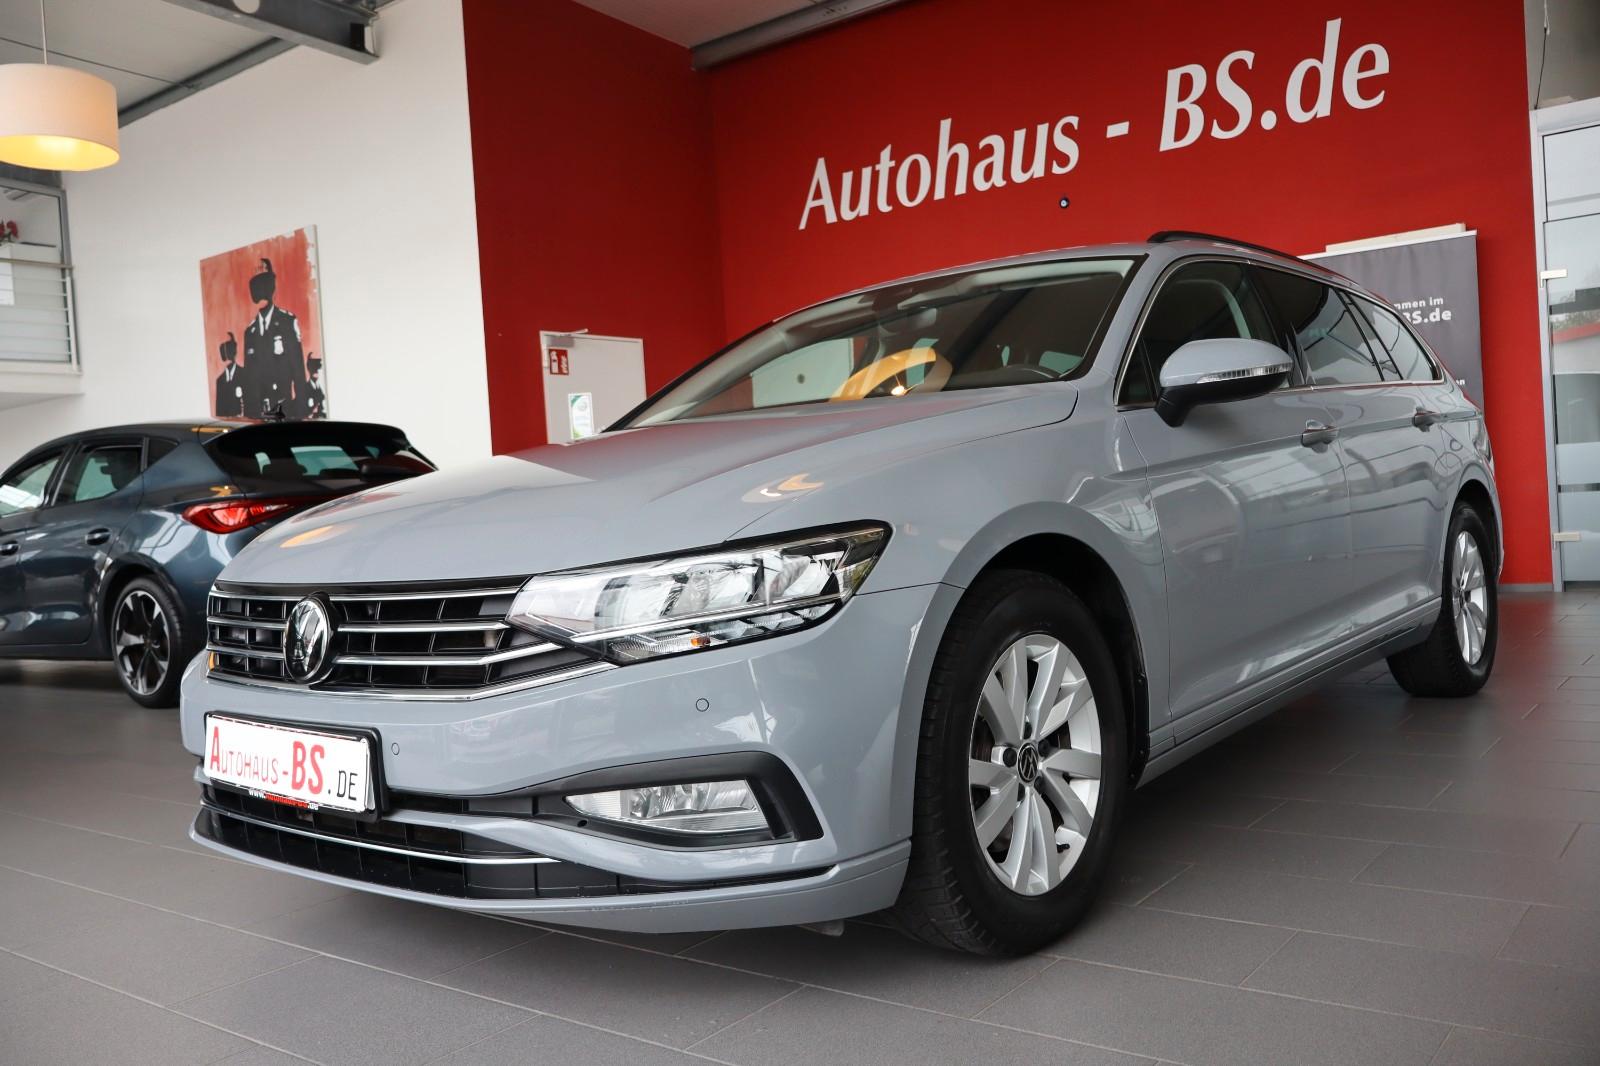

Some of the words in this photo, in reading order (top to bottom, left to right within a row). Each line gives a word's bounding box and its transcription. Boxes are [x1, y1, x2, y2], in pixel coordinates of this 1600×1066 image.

[799, 116, 1079, 230] Autohaus
[1106, 121, 1130, 138] -
[1159, 18, 1390, 152] BS.de
[1429, 296, 1444, 306] im
